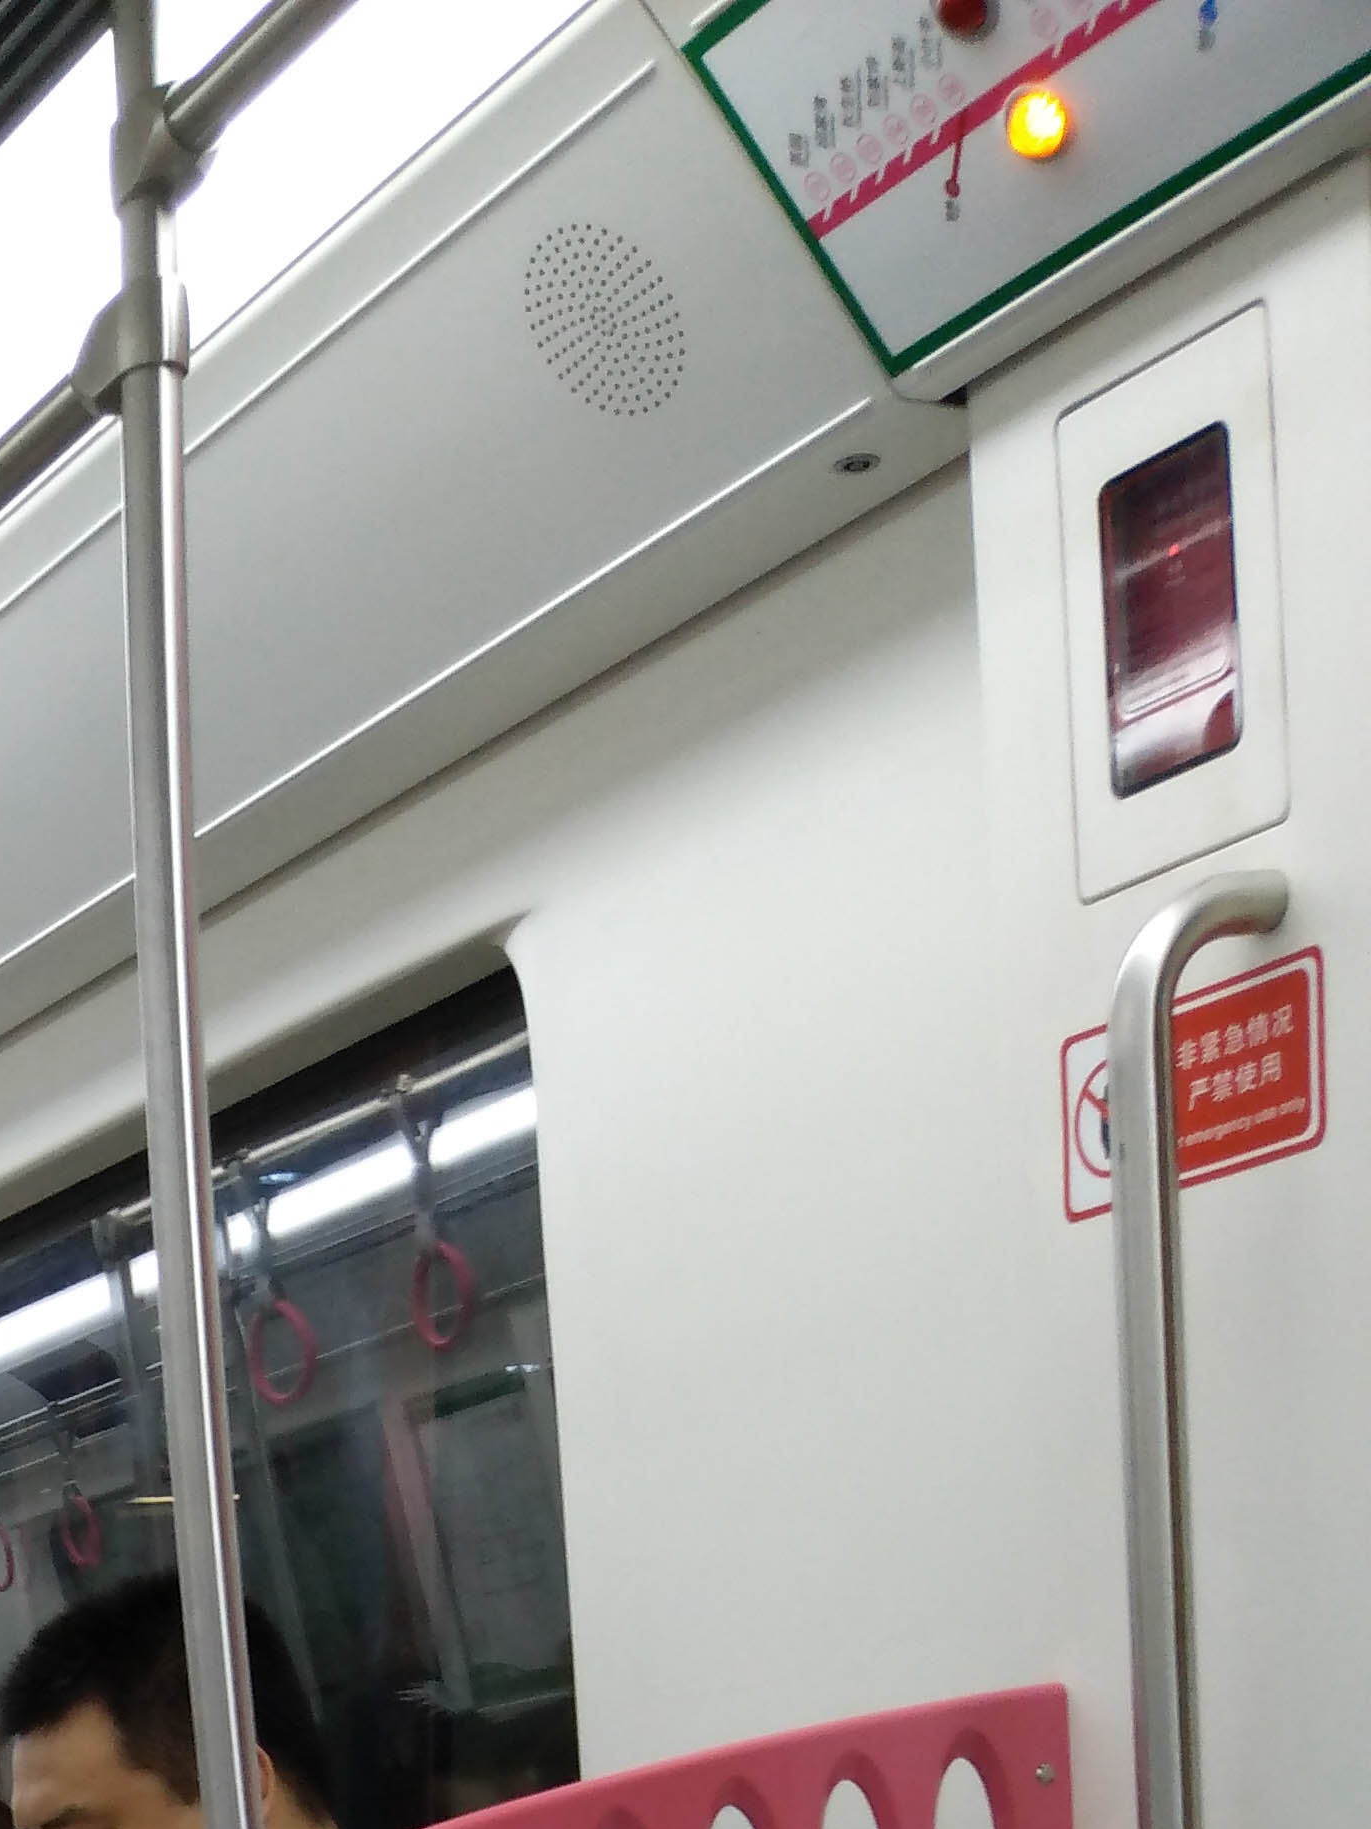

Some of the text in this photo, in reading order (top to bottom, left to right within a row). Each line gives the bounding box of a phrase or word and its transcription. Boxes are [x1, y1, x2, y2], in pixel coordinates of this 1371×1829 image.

[1175, 1003, 1294, 1071] 非紧急情况
[1187, 1050, 1282, 1112] 严禁使用
[1185, 1115, 1253, 1147] emergency
[1278, 1096, 1307, 1116] only
